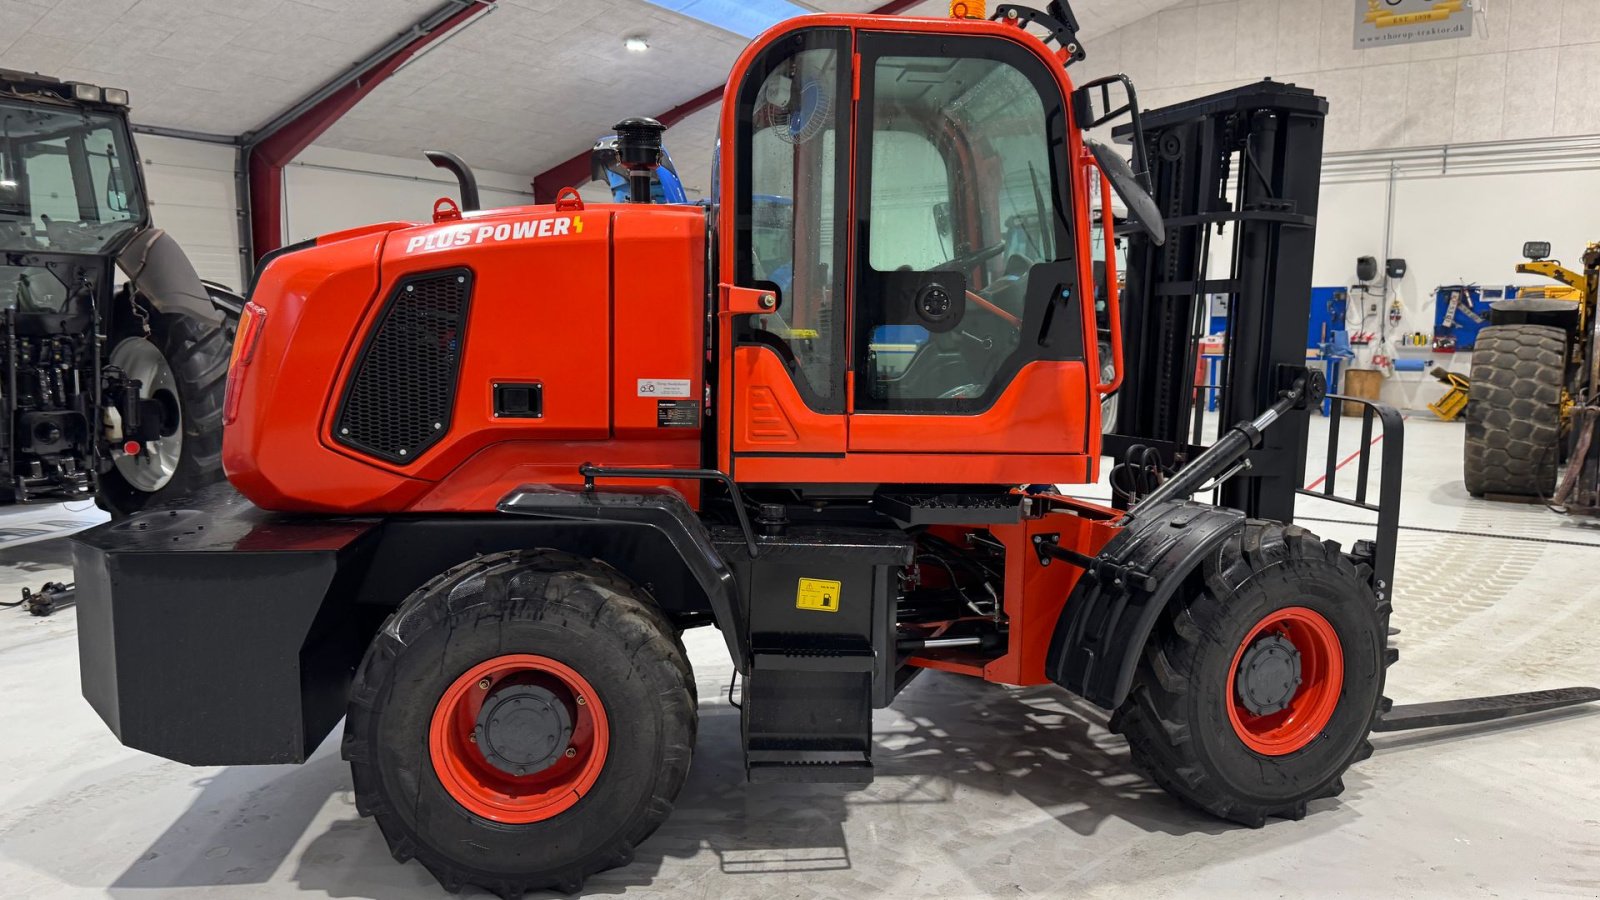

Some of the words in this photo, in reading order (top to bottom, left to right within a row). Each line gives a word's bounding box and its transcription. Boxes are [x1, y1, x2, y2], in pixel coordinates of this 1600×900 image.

[1360, 24, 1465, 42] www.thorup-traktor.dk
[406, 228, 472, 253] PLUS
[475, 217, 571, 244] POWER
